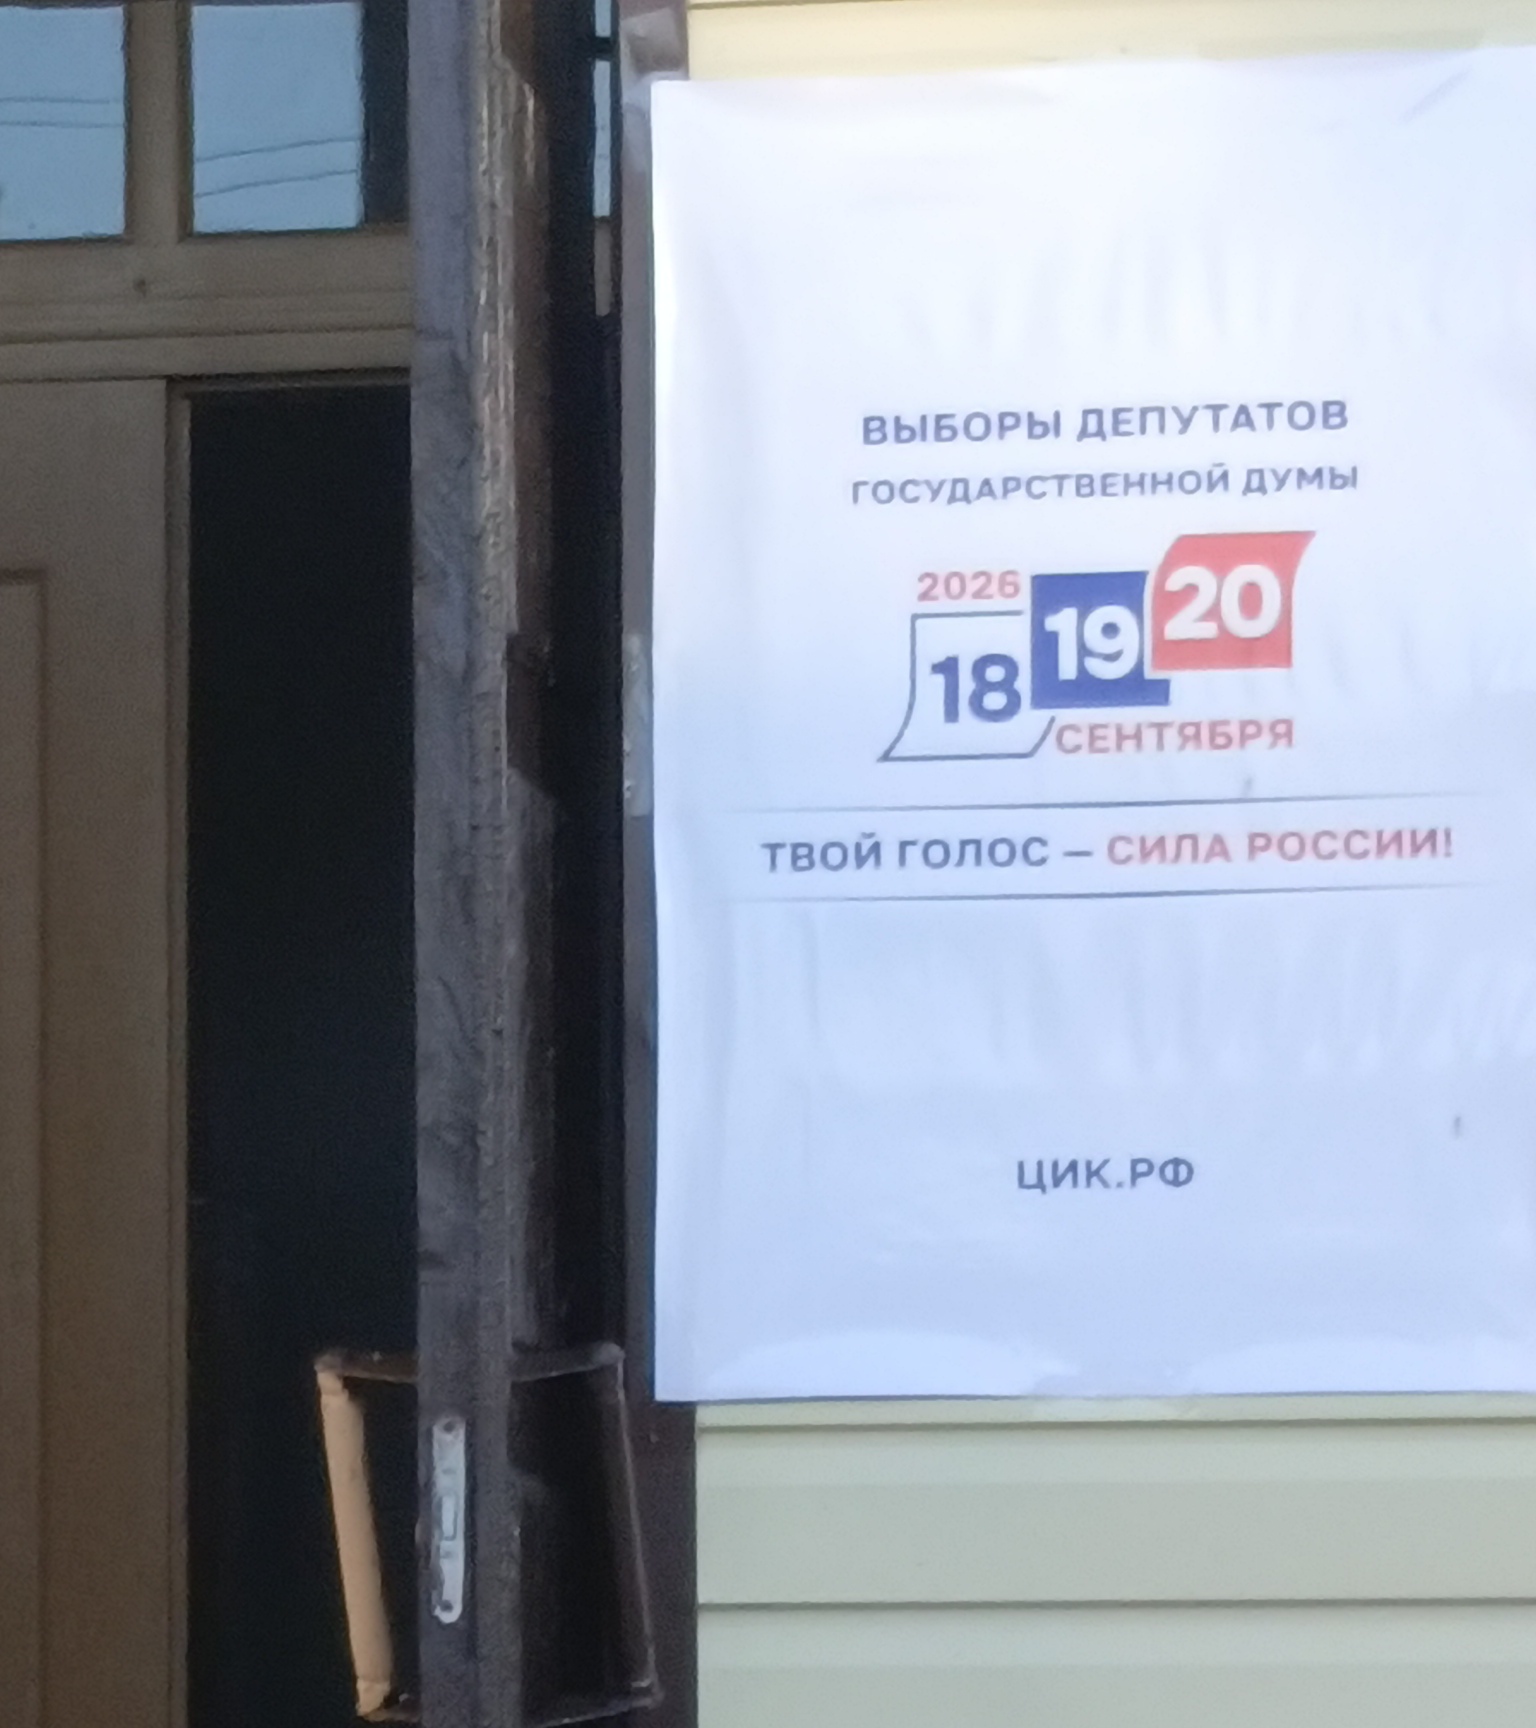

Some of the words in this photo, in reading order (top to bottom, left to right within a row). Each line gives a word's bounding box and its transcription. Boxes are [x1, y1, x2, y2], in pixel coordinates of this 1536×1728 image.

[863, 410, 1062, 446] ВЫБОРЫ
[1077, 399, 1349, 443] ДЕПУТАТОВ
[852, 462, 1230, 506] ГОСУДАРСТВЕННОЙ
[1242, 465, 1358, 497] ДУМЫ
[918, 569, 1021, 602] 2026
[932, 653, 1022, 723] 18
[1044, 605, 1141, 681] 19
[1162, 564, 1281, 641] 20
[1055, 718, 1294, 755] СЕНТЯБРЯ
[761, 831, 882, 873] ТВОЙ
[898, 836, 1049, 870] ГОЛОС
[1107, 834, 1231, 865] СИЛА
[1247, 827, 1452, 862] РОССИИ!
[1017, 1156, 1195, 1195] ЦИК.РФ
